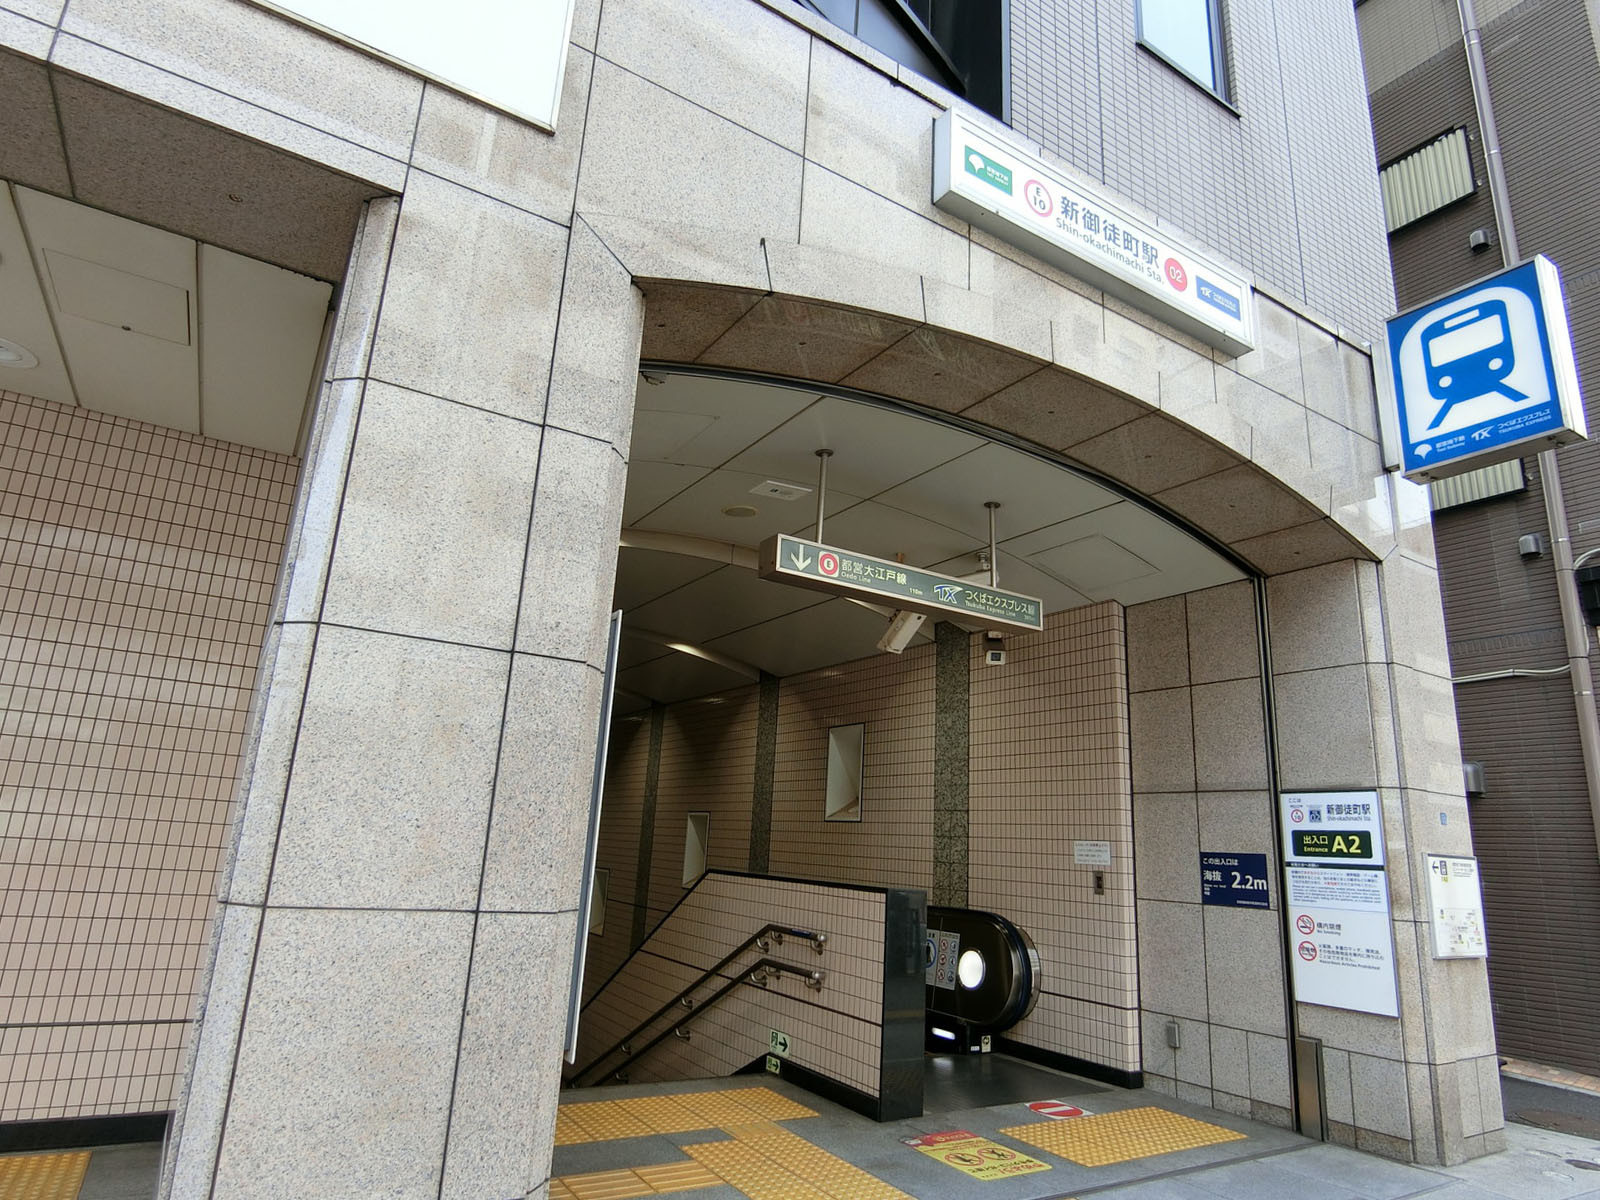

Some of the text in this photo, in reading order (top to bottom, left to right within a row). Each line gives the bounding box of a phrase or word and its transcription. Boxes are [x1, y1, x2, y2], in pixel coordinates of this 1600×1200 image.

[1033, 195, 1046, 211] 10
[1060, 196, 1160, 269] 新御徒町駅
[1056, 217, 1144, 273] Shin-okachimachi
[1471, 426, 1495, 440] TX
[842, 559, 907, 585] 都営大江戸線
[858, 575, 872, 583] Line
[934, 584, 964, 604] TX
[965, 590, 1035, 616] つくばエクスプレス線
[1327, 804, 1371, 815] 新御徒町駅
[1304, 835, 1328, 844] 出入口
[1332, 835, 1361, 853] A2
[1203, 857, 1239, 866] この出入口は
[1203, 870, 1267, 890] 海抜 2.2m
